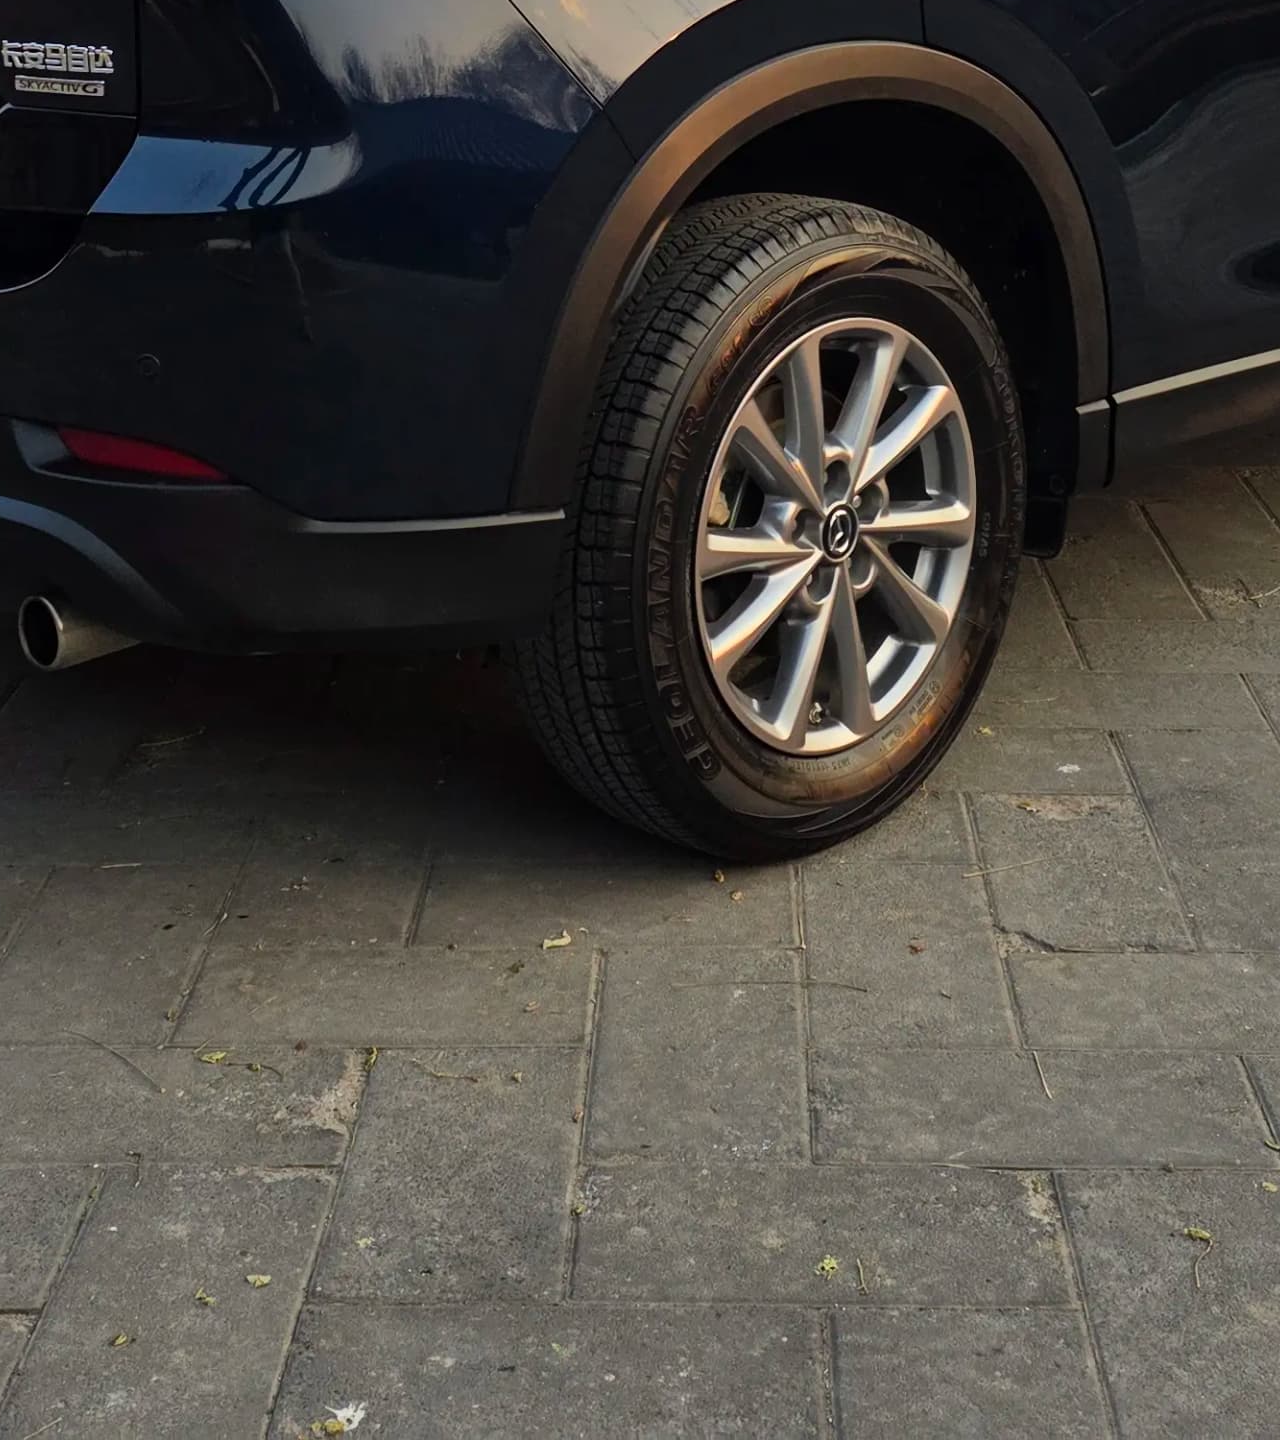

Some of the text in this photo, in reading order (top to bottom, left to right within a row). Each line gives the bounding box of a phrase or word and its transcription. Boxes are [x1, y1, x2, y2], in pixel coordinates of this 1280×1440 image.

[1, 40, 114, 74] 长安马自达
[647, 405, 721, 781] GEOLANDAR
